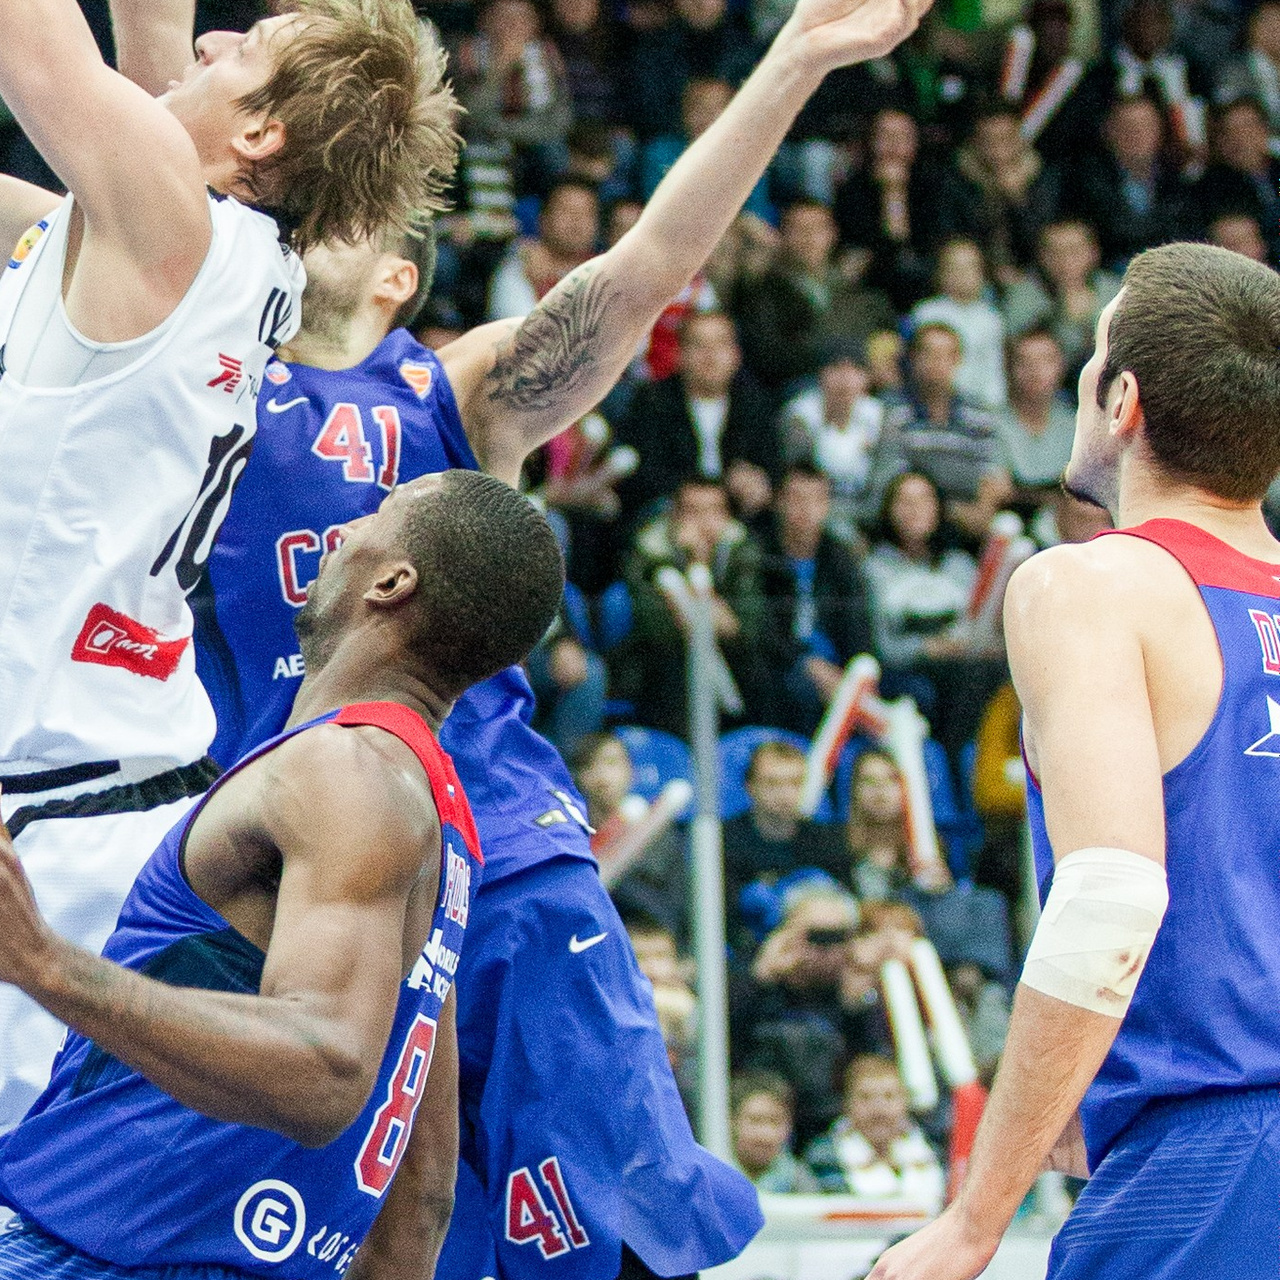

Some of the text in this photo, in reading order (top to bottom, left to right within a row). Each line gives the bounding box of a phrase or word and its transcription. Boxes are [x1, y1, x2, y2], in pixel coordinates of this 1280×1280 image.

[311, 402, 401, 493] 41
[276, 524, 348, 608] C
[1248, 609, 1280, 675] D
[354, 1012, 437, 1199] 8
[505, 1156, 591, 1260] 41
